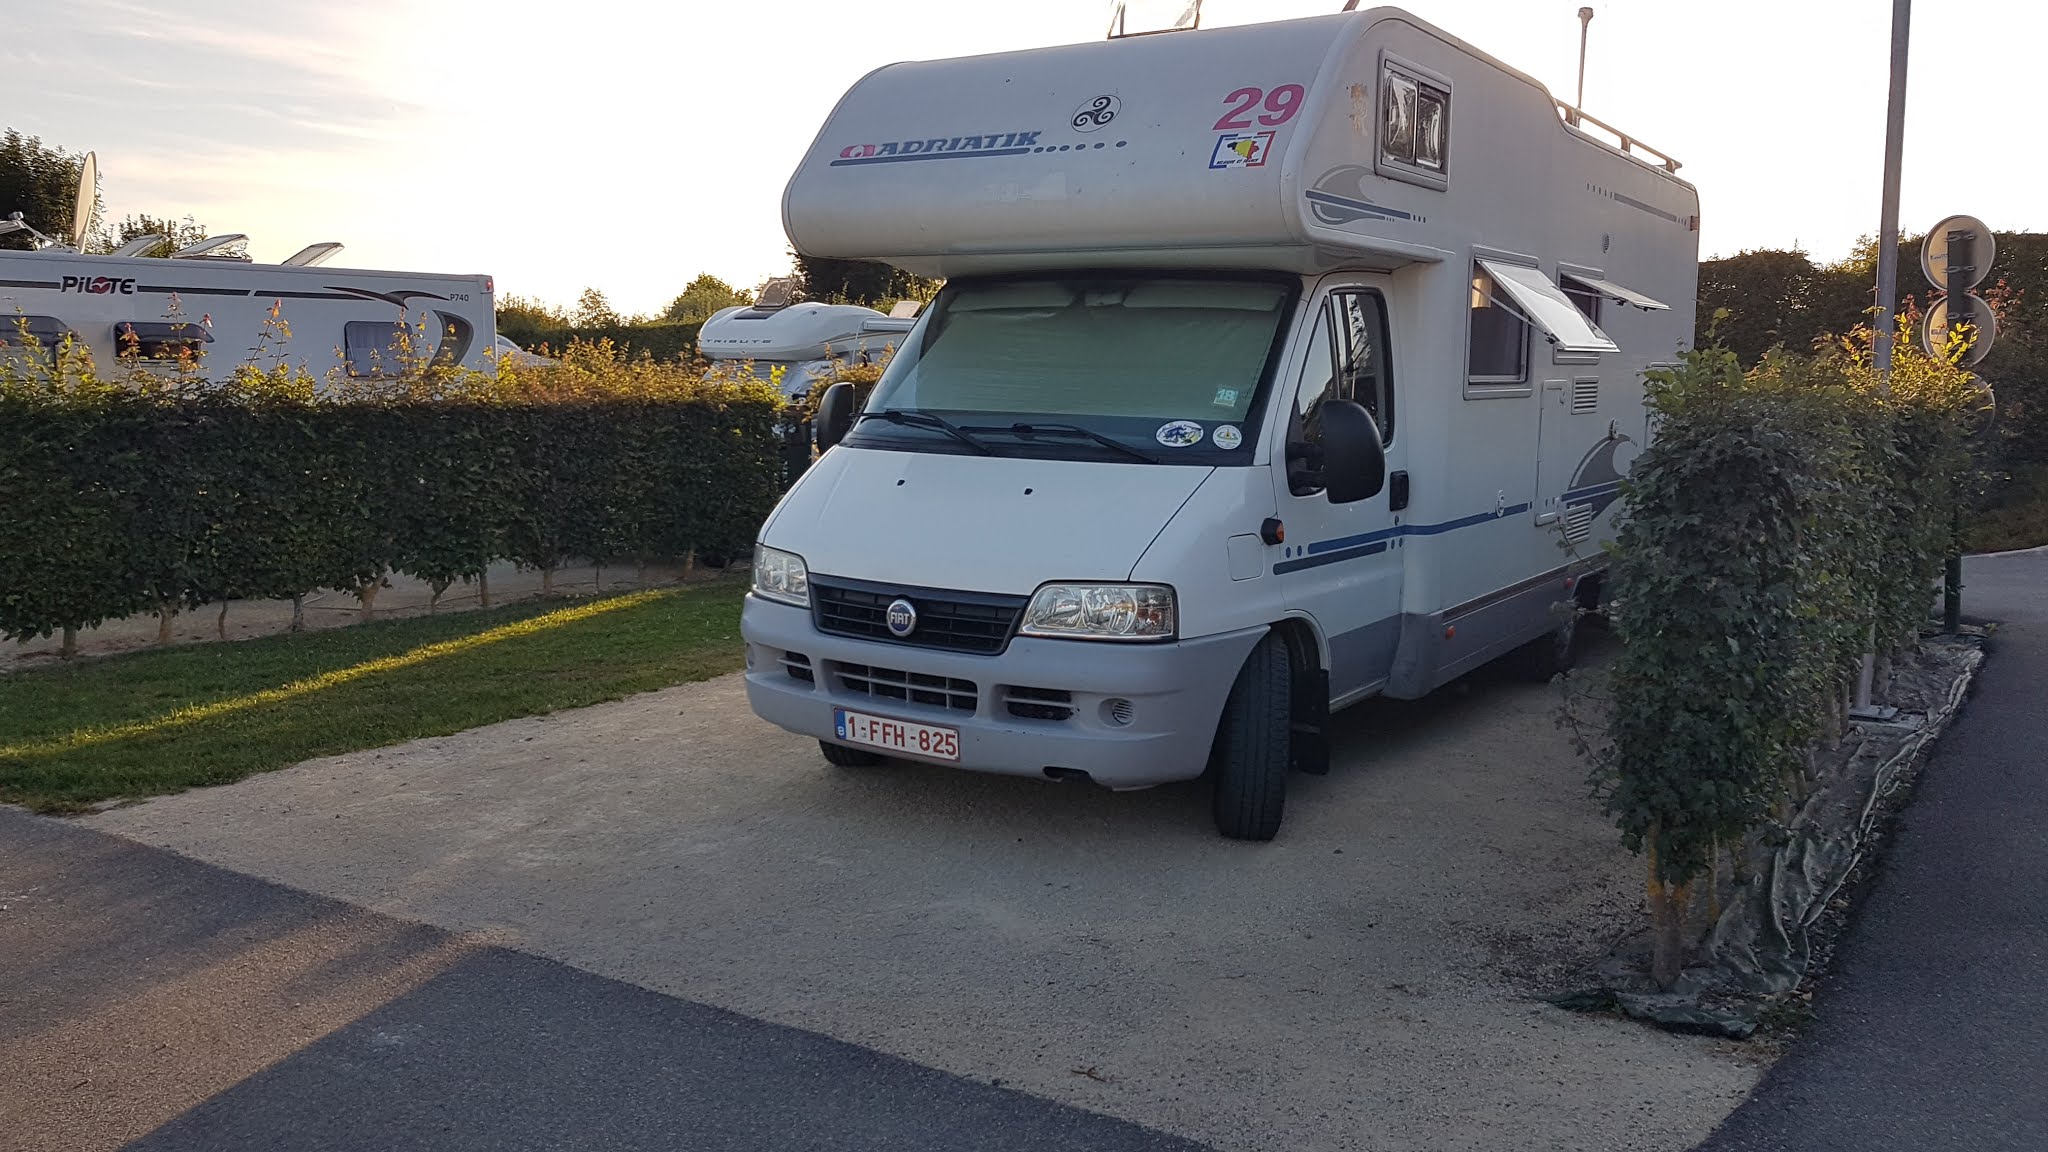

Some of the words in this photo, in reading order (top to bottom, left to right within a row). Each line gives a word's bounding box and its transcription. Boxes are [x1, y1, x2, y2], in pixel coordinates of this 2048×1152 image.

[1212, 84, 1305, 130] 29
[875, 131, 1042, 156] ADRIATIK
[450, 293, 469, 302] P740
[1217, 388, 1236, 401] 18
[890, 612, 910, 625] FIAT
[837, 726, 845, 736] B
[848, 716, 957, 756] 1-FFH-825
